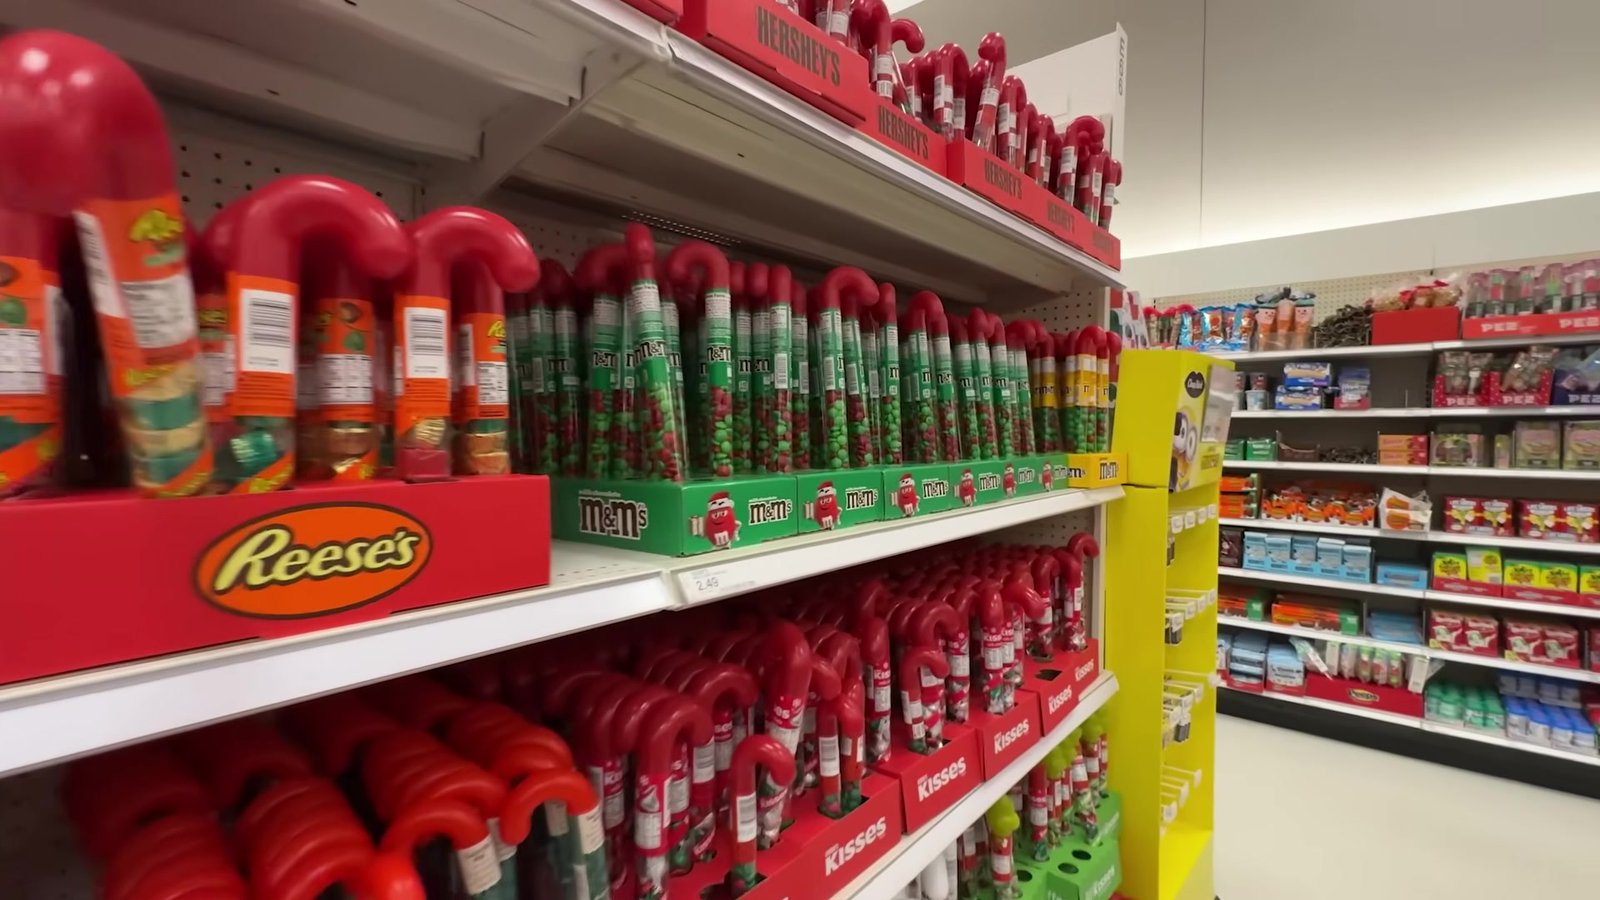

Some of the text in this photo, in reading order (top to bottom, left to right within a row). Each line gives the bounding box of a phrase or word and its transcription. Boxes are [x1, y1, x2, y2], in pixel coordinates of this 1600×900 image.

[757, 6, 840, 86] HERSHEY'S
[879, 105, 929, 160] HERSHEY'S
[213, 526, 420, 592] Reese's
[994, 719, 1030, 755] Kisses
[918, 756, 967, 802] Kisses
[826, 816, 887, 877] Kisses
